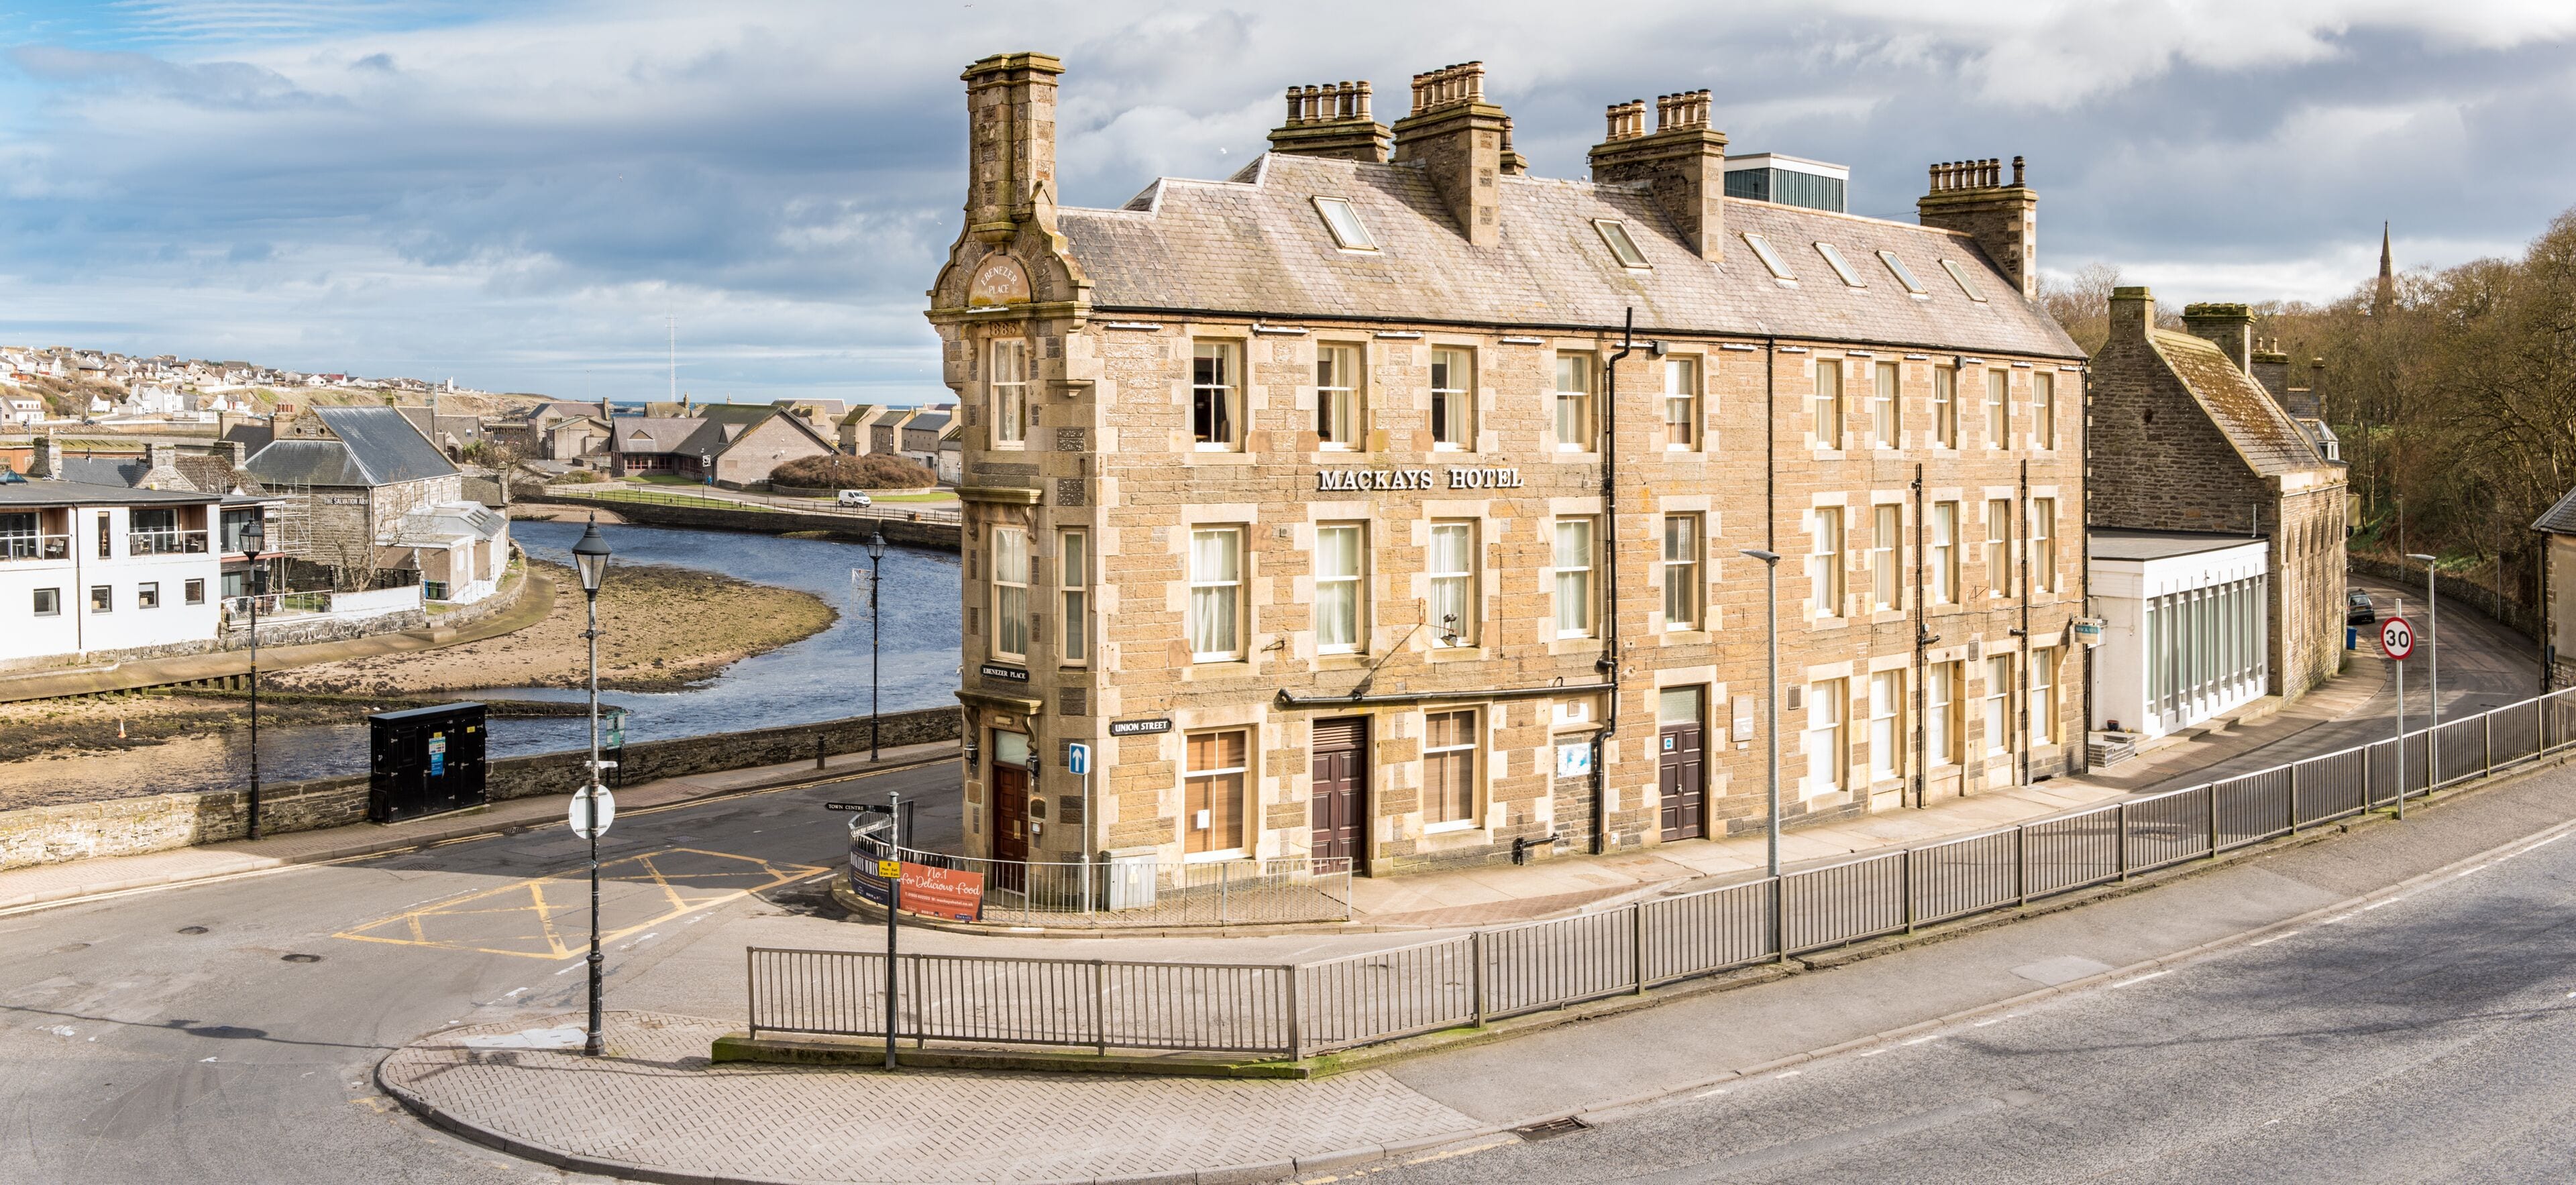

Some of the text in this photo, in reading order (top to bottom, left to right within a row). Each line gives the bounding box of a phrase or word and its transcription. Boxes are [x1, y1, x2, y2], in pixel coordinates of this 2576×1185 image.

[981, 266, 1017, 286] EBENEZER
[989, 284, 1009, 294] PLACE
[1320, 467, 1524, 490] MACKAYS HOTEL
[2385, 629, 2409, 648] 30
[983, 667, 1008, 677] EBENEZER
[1115, 721, 1167, 732] UNION STREET
[928, 866, 947, 880] No.1
[915, 875, 954, 892] Delicious
